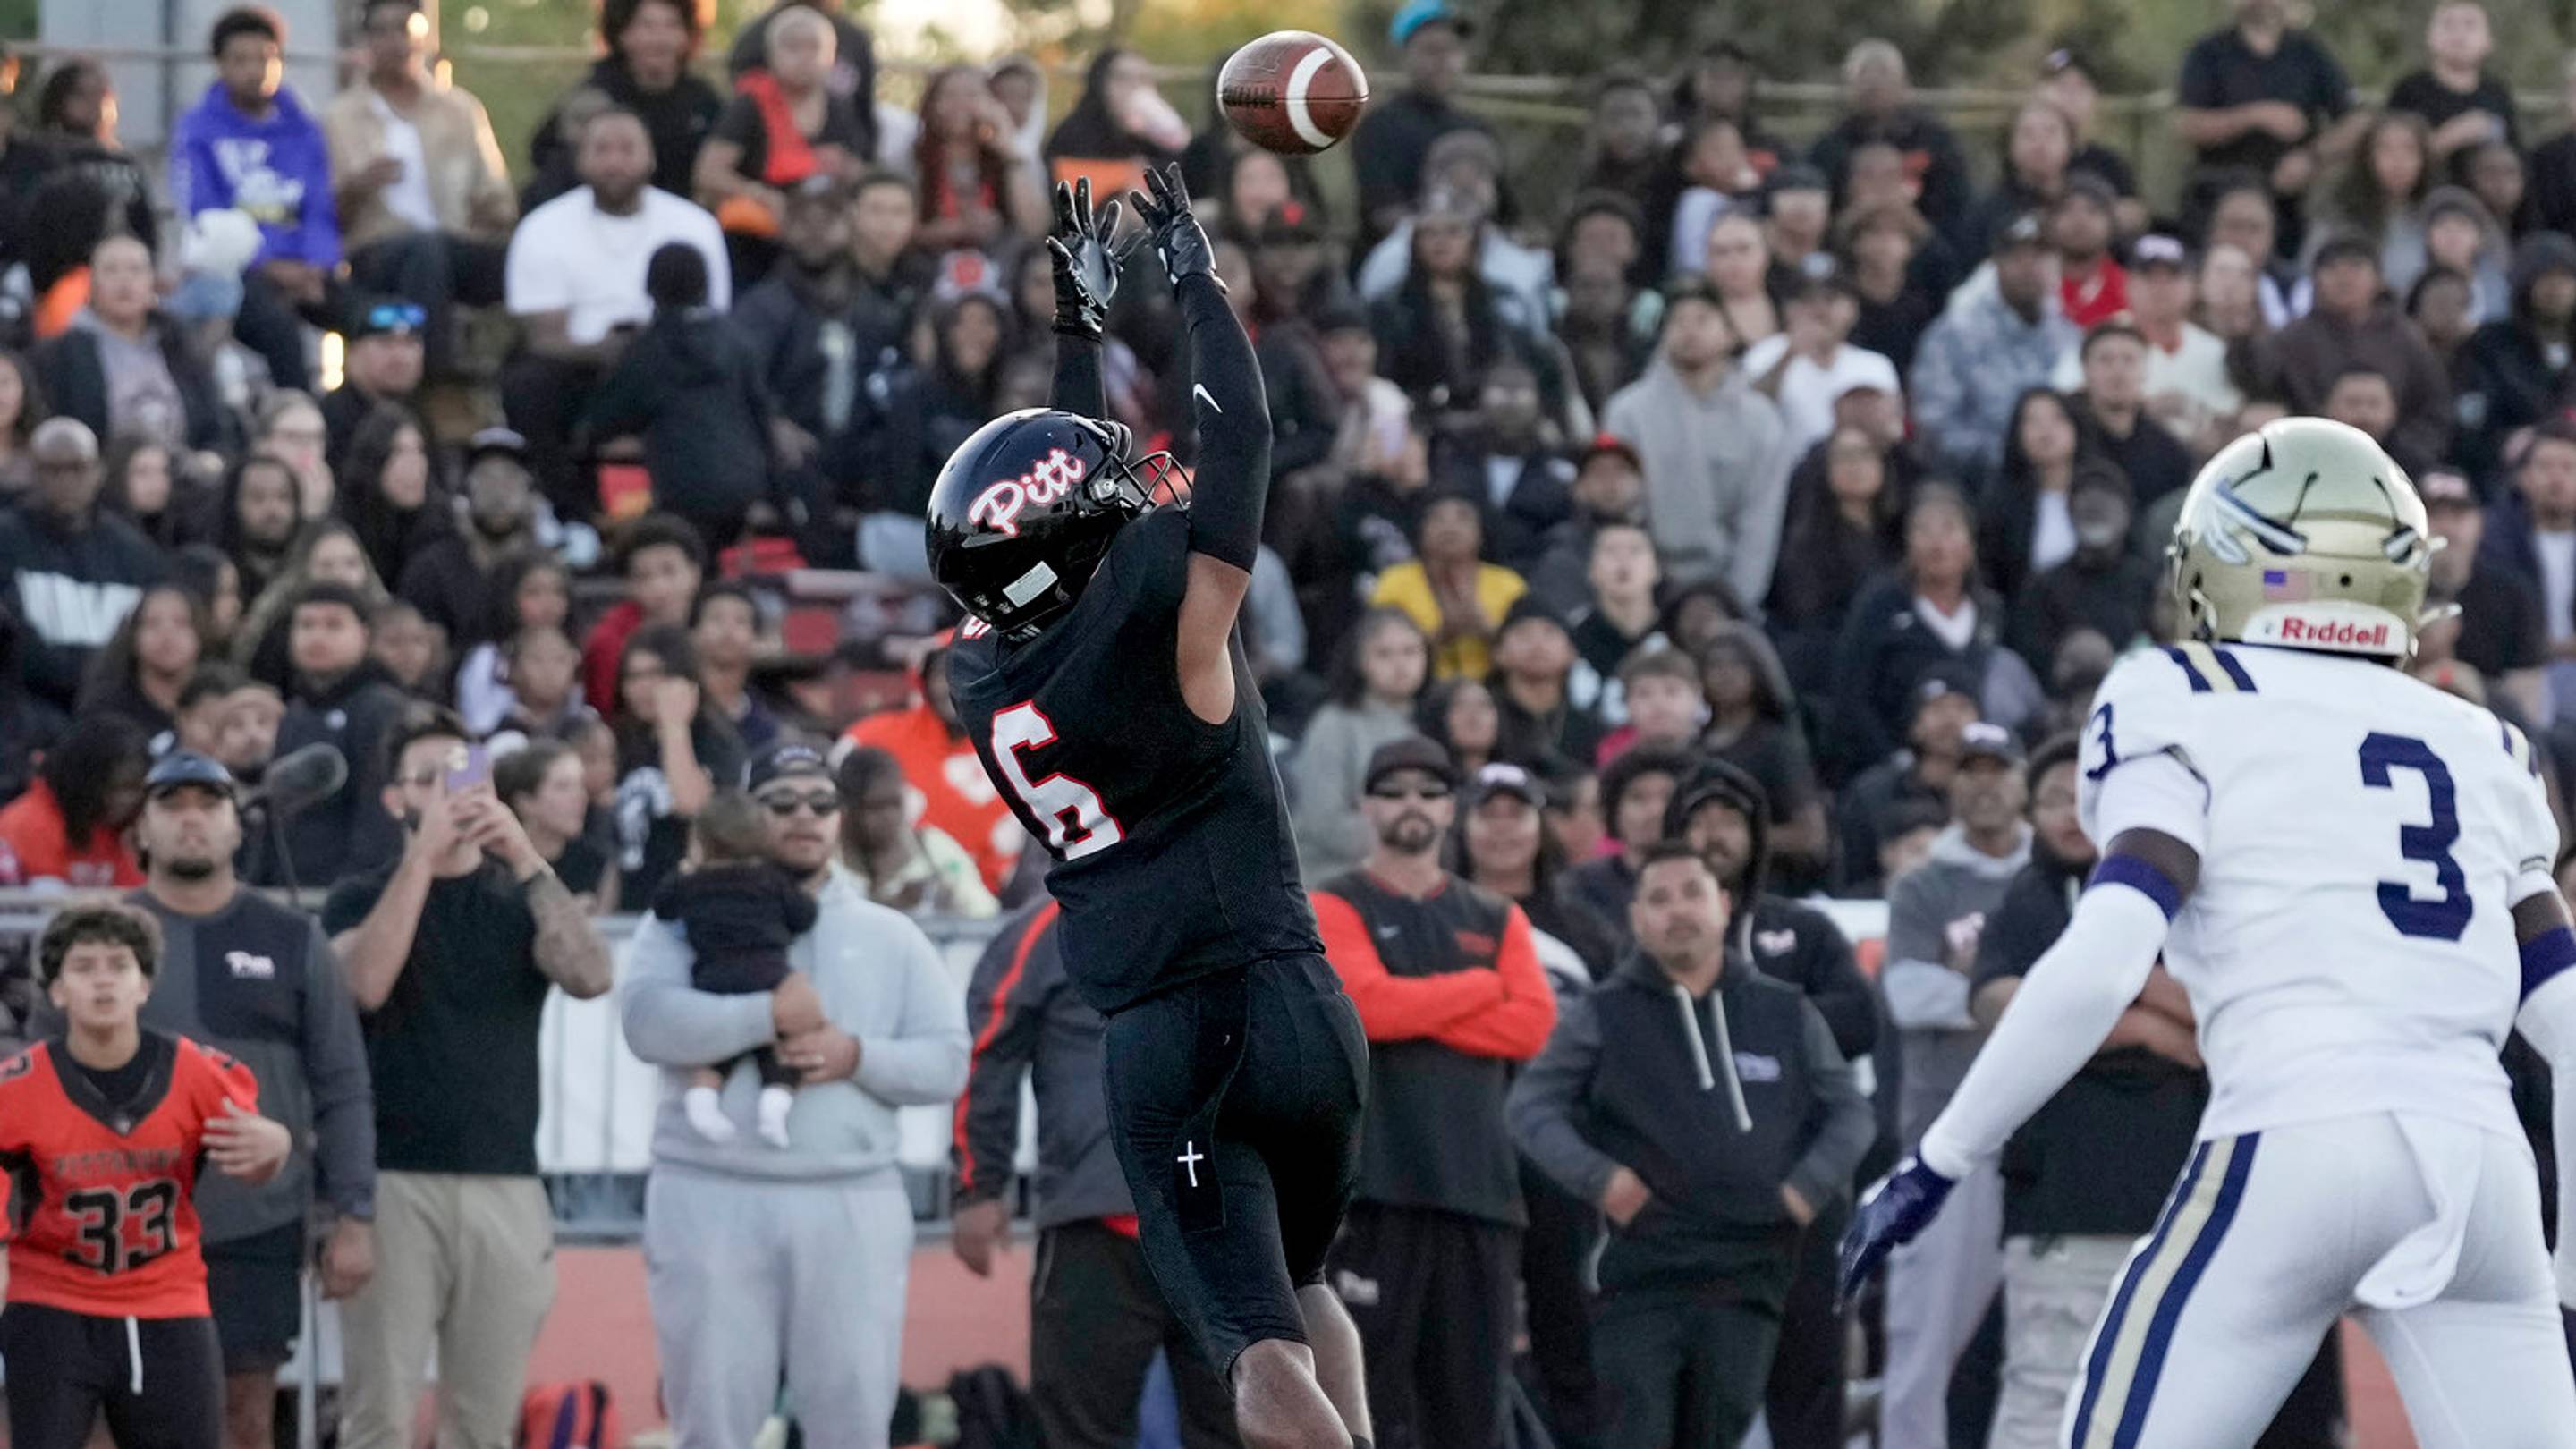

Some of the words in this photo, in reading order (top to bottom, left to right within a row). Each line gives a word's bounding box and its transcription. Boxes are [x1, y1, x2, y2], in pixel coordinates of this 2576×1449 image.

[968, 447, 1087, 538] Pitt
[2282, 615, 2390, 648] Riddell
[991, 699, 1127, 862] 6
[2358, 731, 2473, 942] 3
[63, 1177, 181, 1277] 33
